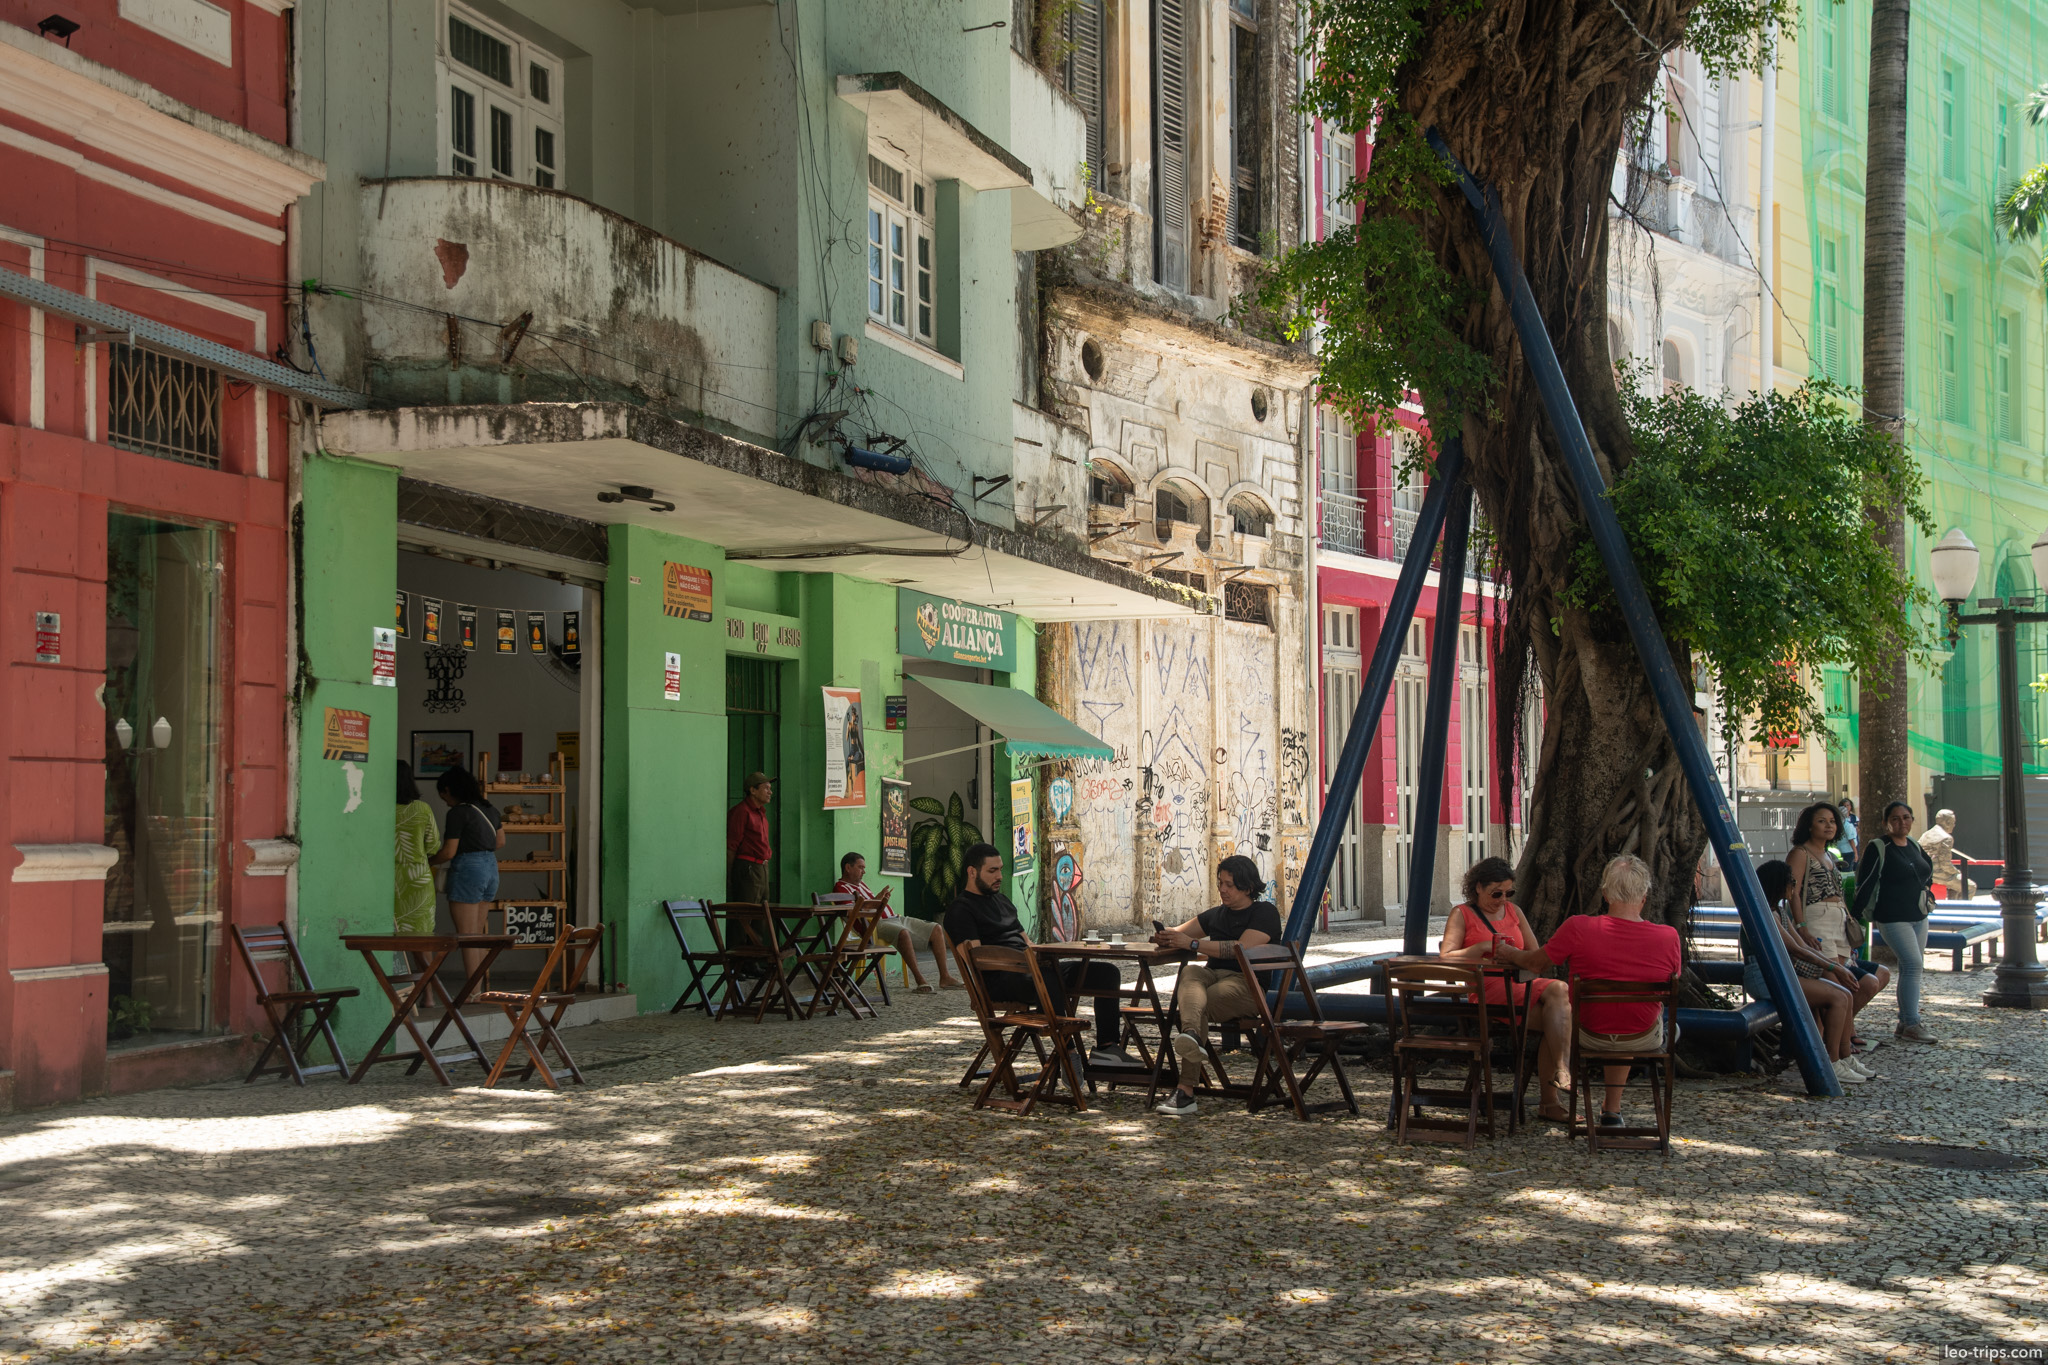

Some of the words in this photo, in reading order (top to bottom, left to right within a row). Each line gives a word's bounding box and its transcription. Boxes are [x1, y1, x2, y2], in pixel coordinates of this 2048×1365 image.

[942, 603, 1003, 631] COOPERATIVA
[777, 626, 801, 648] JESUS
[941, 622, 1004, 661] ALIANÇA
[375, 651, 395, 662] Alarme
[425, 656, 467, 669] LANE
[427, 667, 464, 679] BOLO
[436, 678, 455, 690] DE
[427, 688, 464, 701] ROLO
[883, 835, 898, 848] APOSTE
[506, 906, 537, 924] Bolo
[540, 907, 553, 922] de
